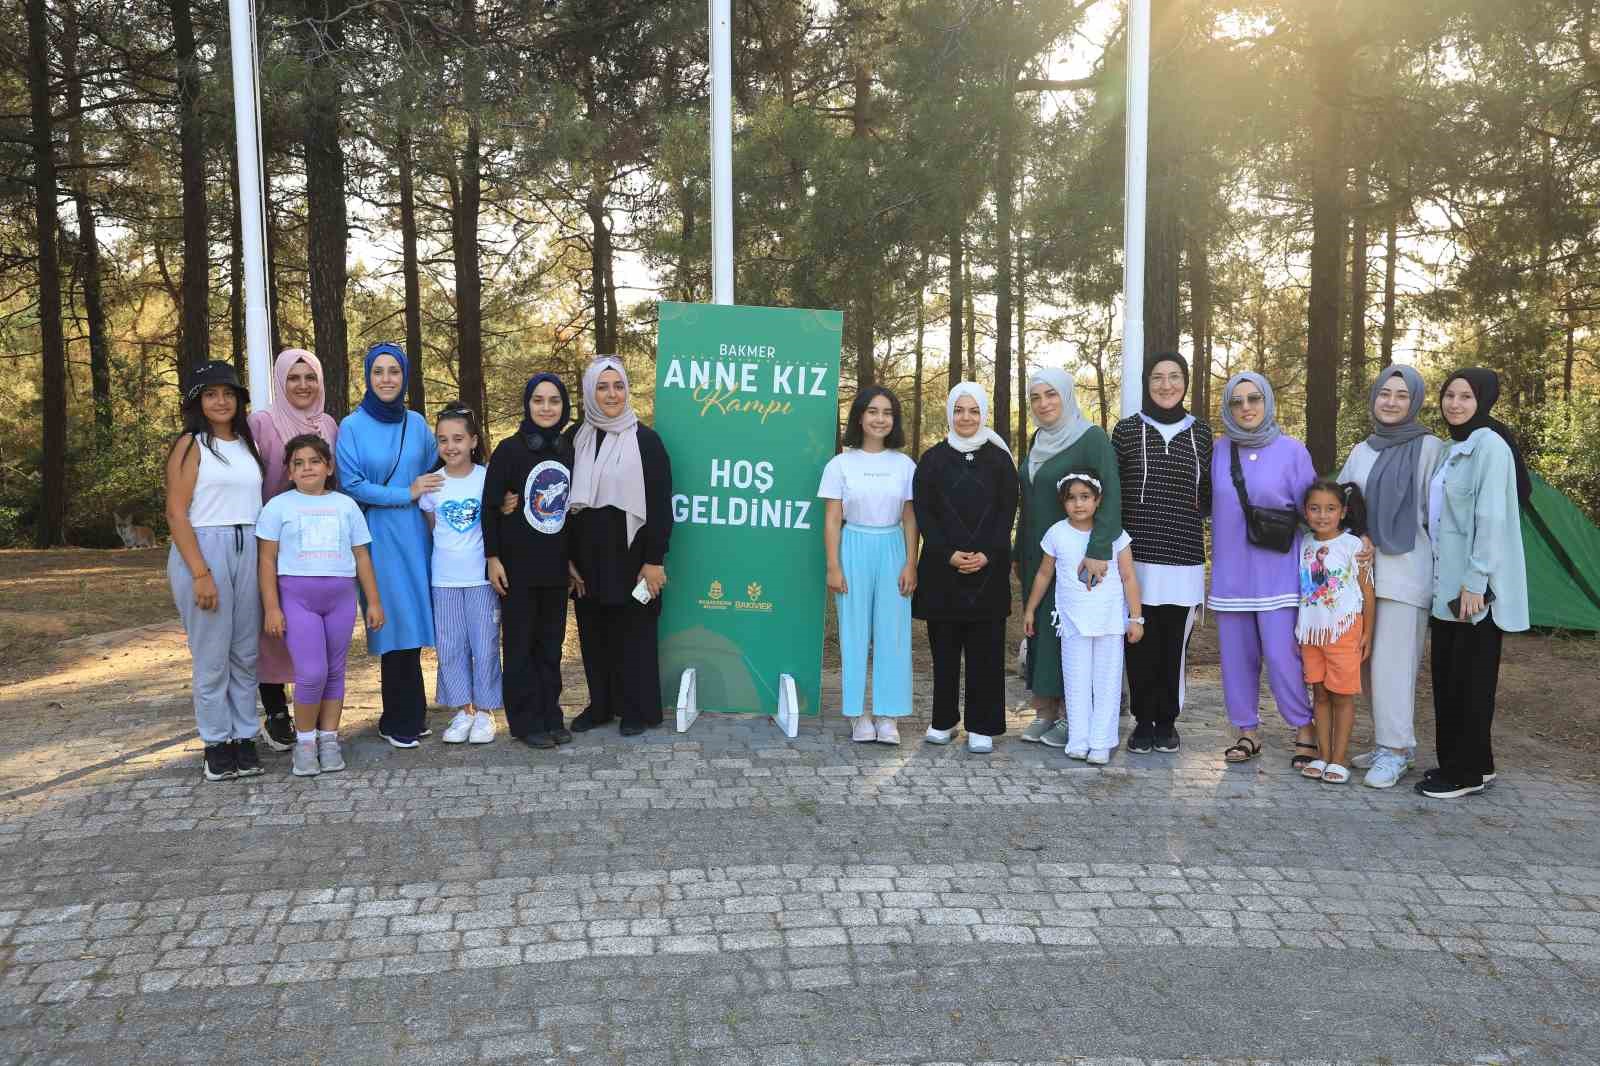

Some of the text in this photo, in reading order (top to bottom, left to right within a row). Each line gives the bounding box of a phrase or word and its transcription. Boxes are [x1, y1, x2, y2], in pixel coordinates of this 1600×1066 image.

[719, 343, 776, 358] BAKMER
[663, 359, 828, 396] ANNE KIZ
[710, 458, 774, 493] HOŞ
[672, 494, 811, 529] GELDİNİZ
